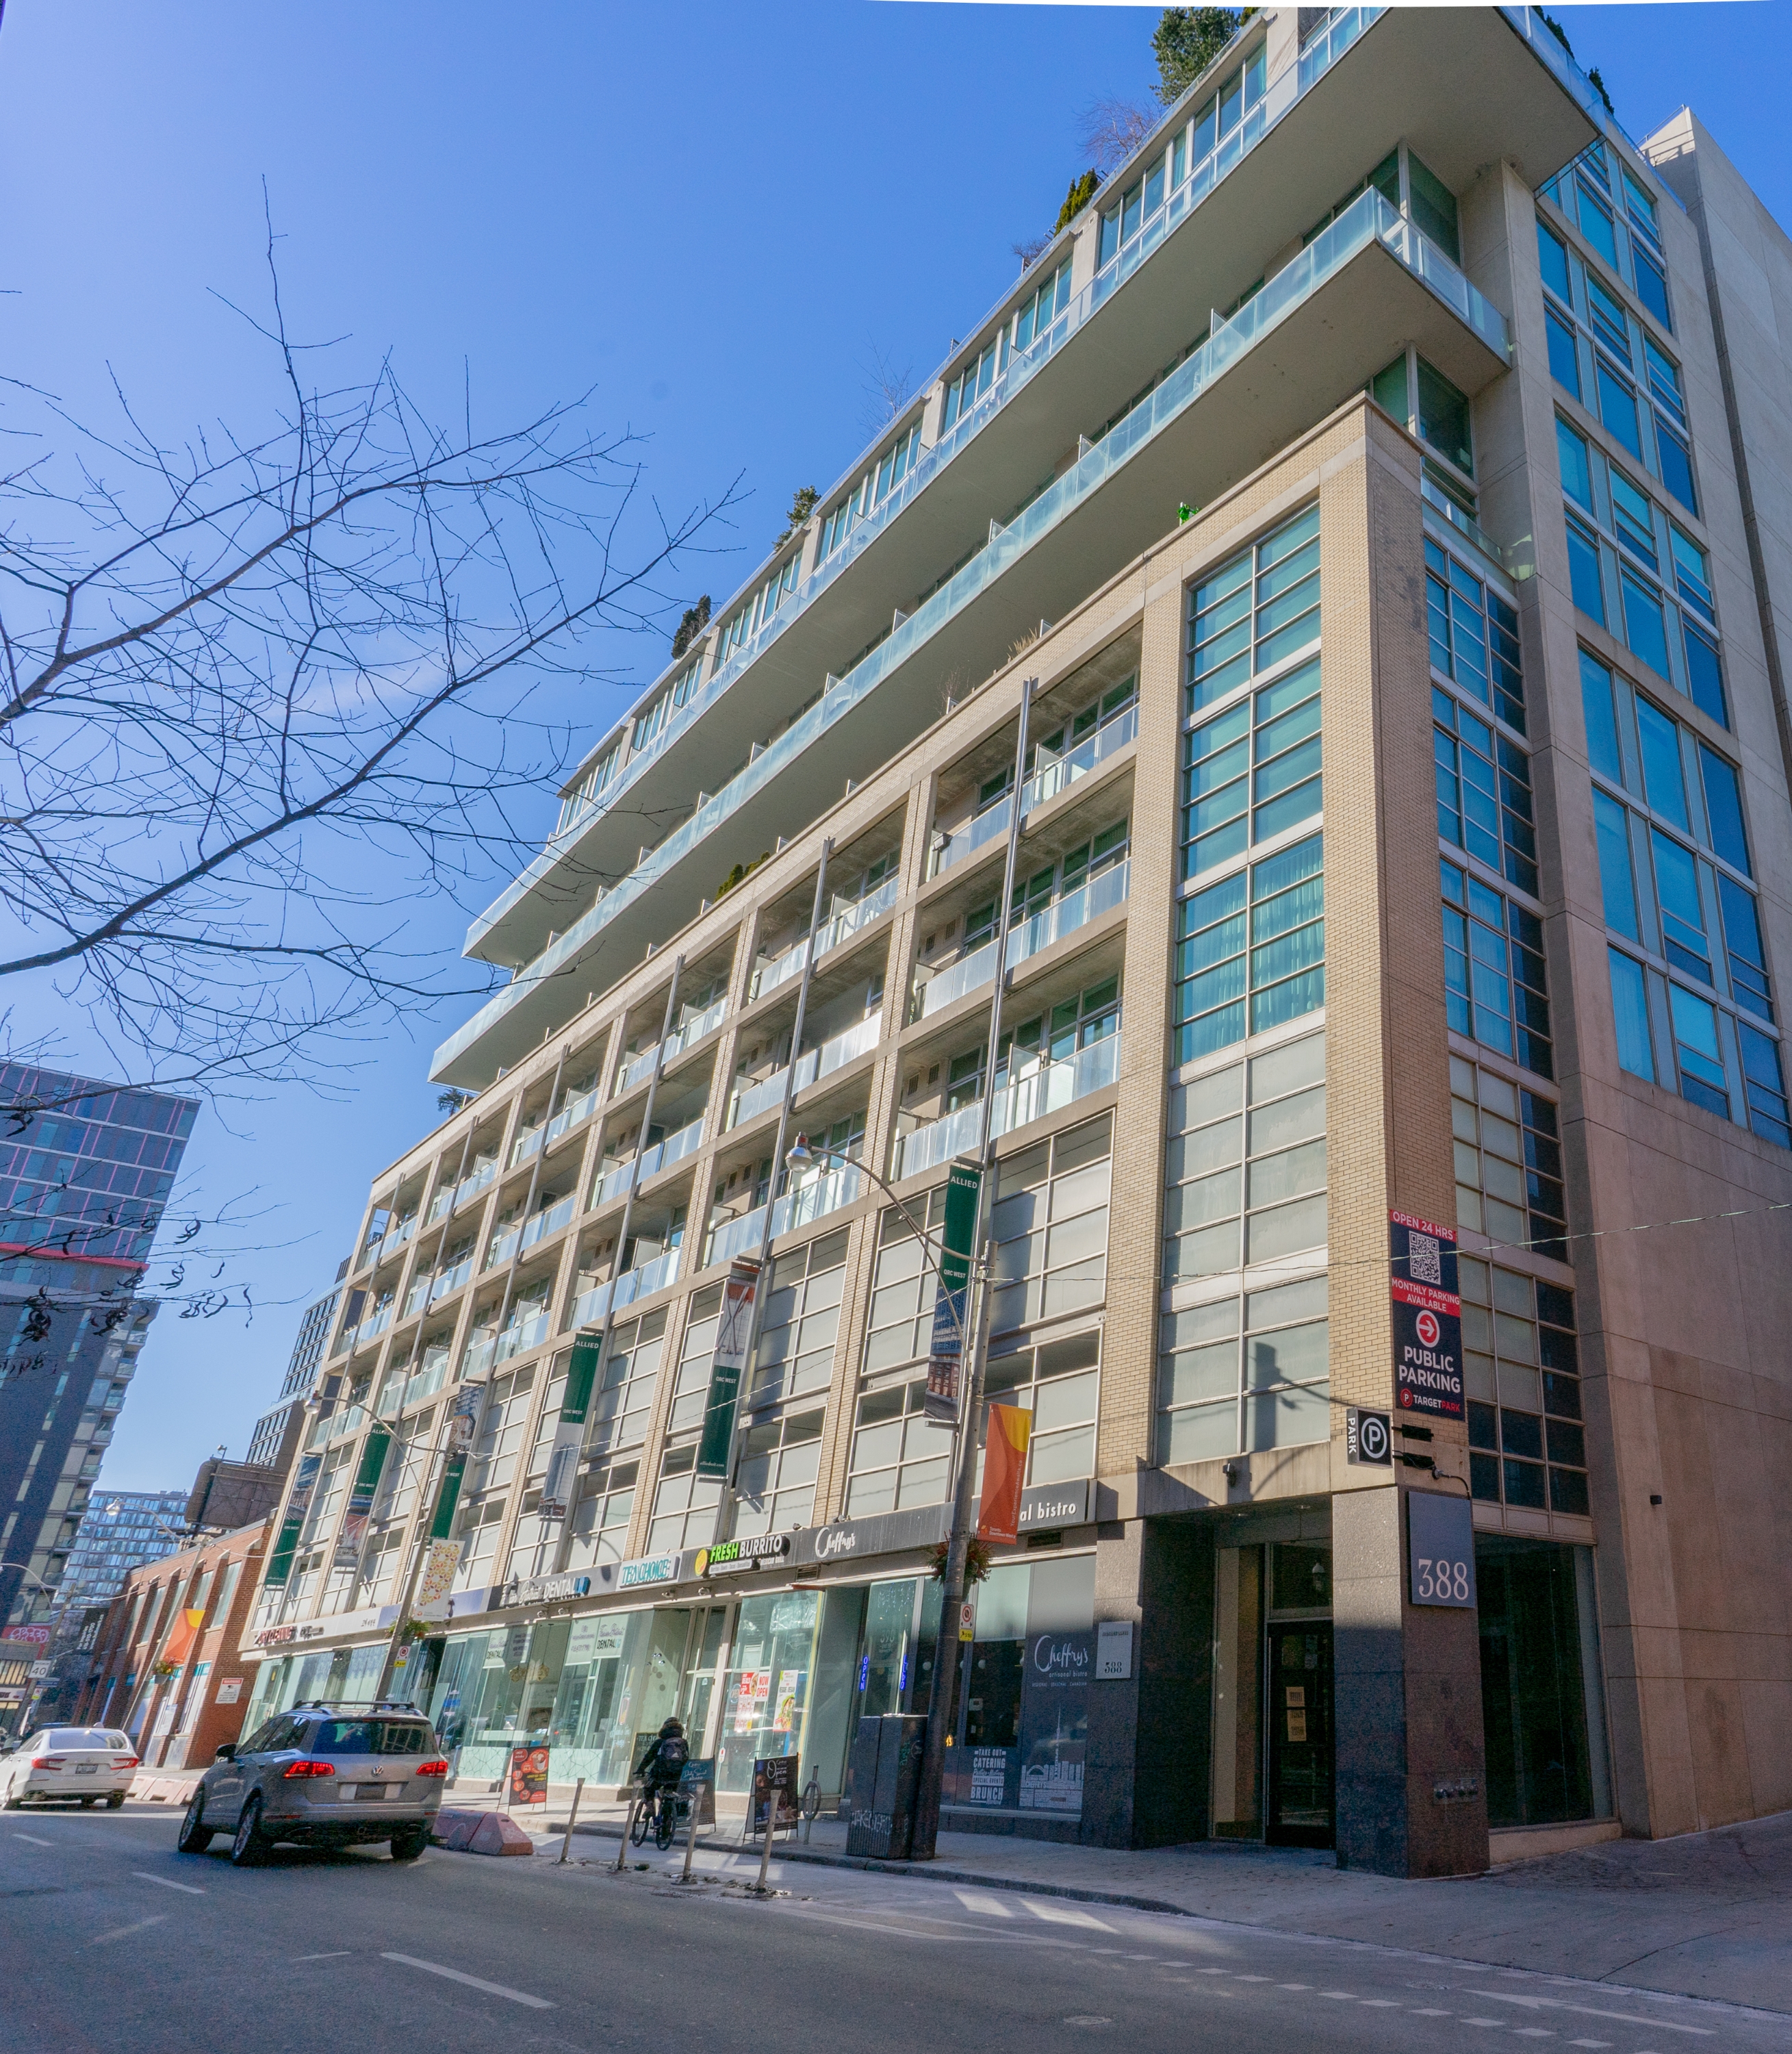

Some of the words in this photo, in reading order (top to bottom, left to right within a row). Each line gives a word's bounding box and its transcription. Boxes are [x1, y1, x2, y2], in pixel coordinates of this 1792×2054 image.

[950, 1176, 977, 1189] ALLIED
[1392, 1211, 1420, 1229] OPEN
[1422, 1221, 1433, 1233] 24
[1435, 1225, 1453, 1240] HRS
[1392, 1278, 1426, 1295] MONTHLY
[1429, 1289, 1460, 1305] PARKING
[1407, 1293, 1447, 1312] AVAILABLE
[575, 1341, 599, 1349] ALLIED
[1404, 1345, 1455, 1372] PUBLIC
[1398, 1365, 1461, 1393] PARKING
[1413, 1395, 1461, 1412] TARGETPARK
[1348, 1417, 1357, 1454] PARK
[1368, 1425, 1381, 1450] P
[1037, 1501, 1077, 1519] bistro
[709, 1542, 739, 1563] FRESH
[739, 1534, 782, 1558] BURRITO
[815, 1527, 856, 1558] Cheffry's
[622, 1564, 639, 1584] TEA
[638, 1559, 671, 1581] CHOICE
[1418, 1558, 1469, 1600] 388
[543, 1577, 576, 1599] DENTAL
[1034, 1634, 1088, 1673] Cheffry's
[31, 1667, 47, 1675] 40
[1104, 1661, 1123, 1673] 388
[756, 1687, 769, 1697] OPEN
[758, 1676, 769, 1686] NOW
[973, 1757, 1006, 1768] CATERING
[971, 1786, 1004, 1800] BRUNCH
